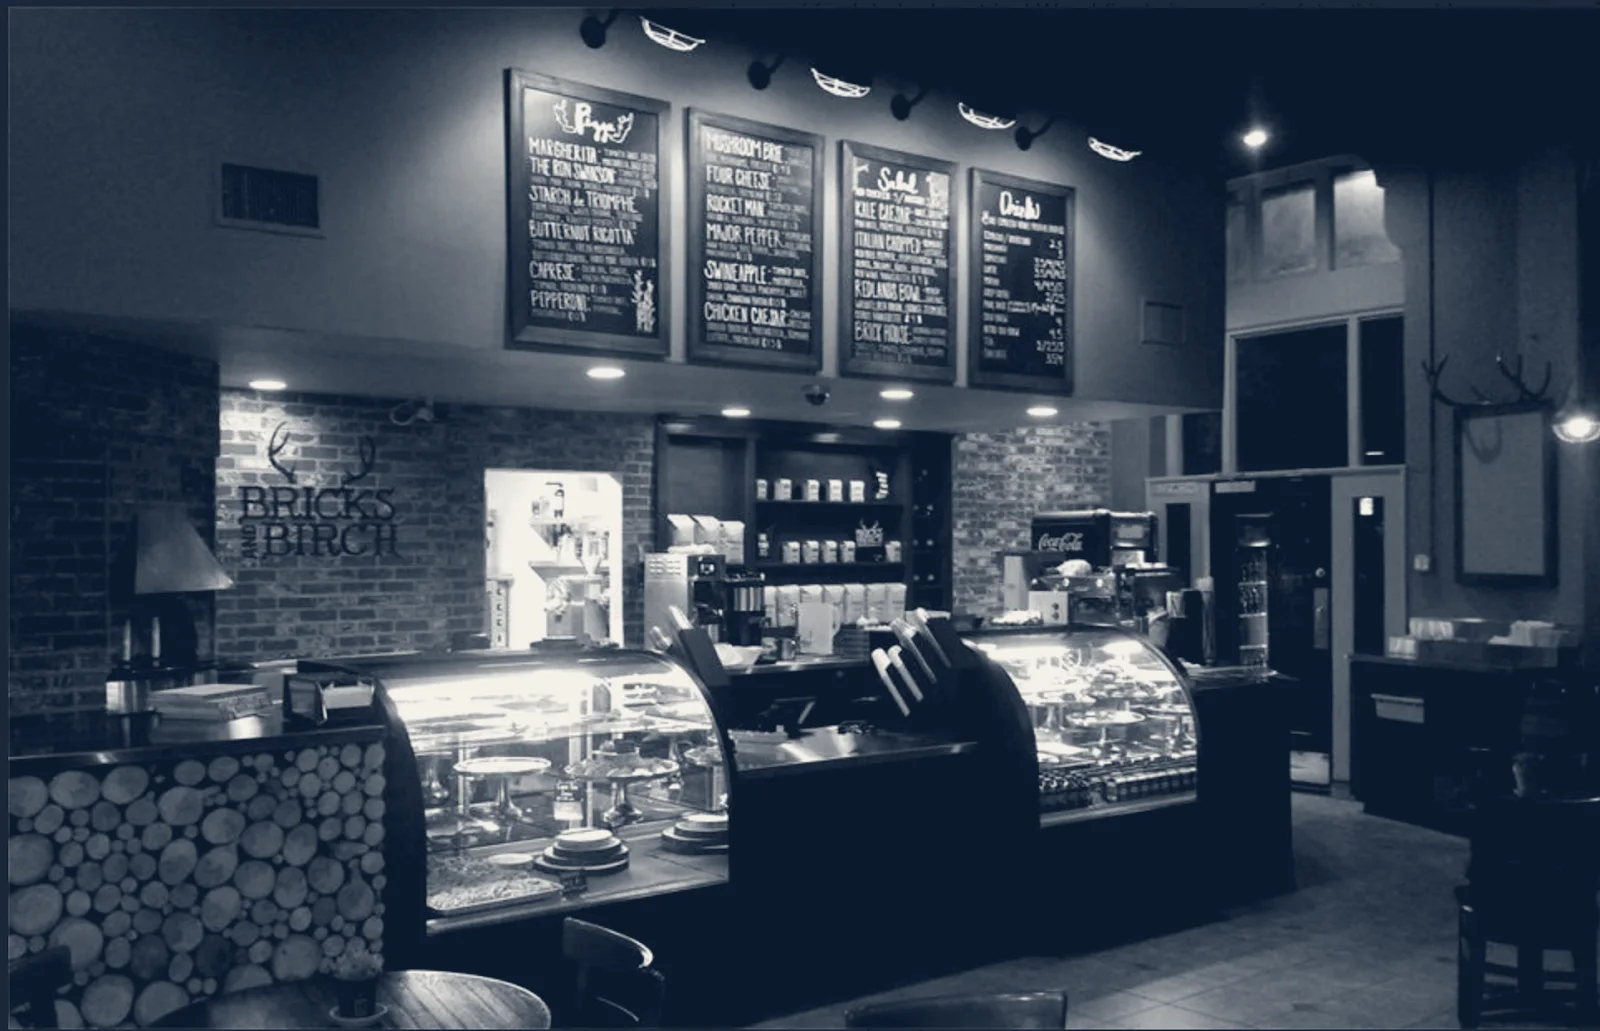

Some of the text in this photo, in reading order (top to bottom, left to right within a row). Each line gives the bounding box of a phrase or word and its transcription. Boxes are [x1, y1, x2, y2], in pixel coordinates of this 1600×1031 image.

[529, 137, 597, 163] MARGHERITA
[530, 157, 550, 176] THE
[529, 185, 571, 206] STARCH
[706, 194, 742, 214] ROCKET
[529, 220, 590, 242] BUTTERNUT
[703, 301, 748, 323] CHICKEN
[238, 485, 396, 526] BRICKS
[261, 521, 403, 560] BIRCH
